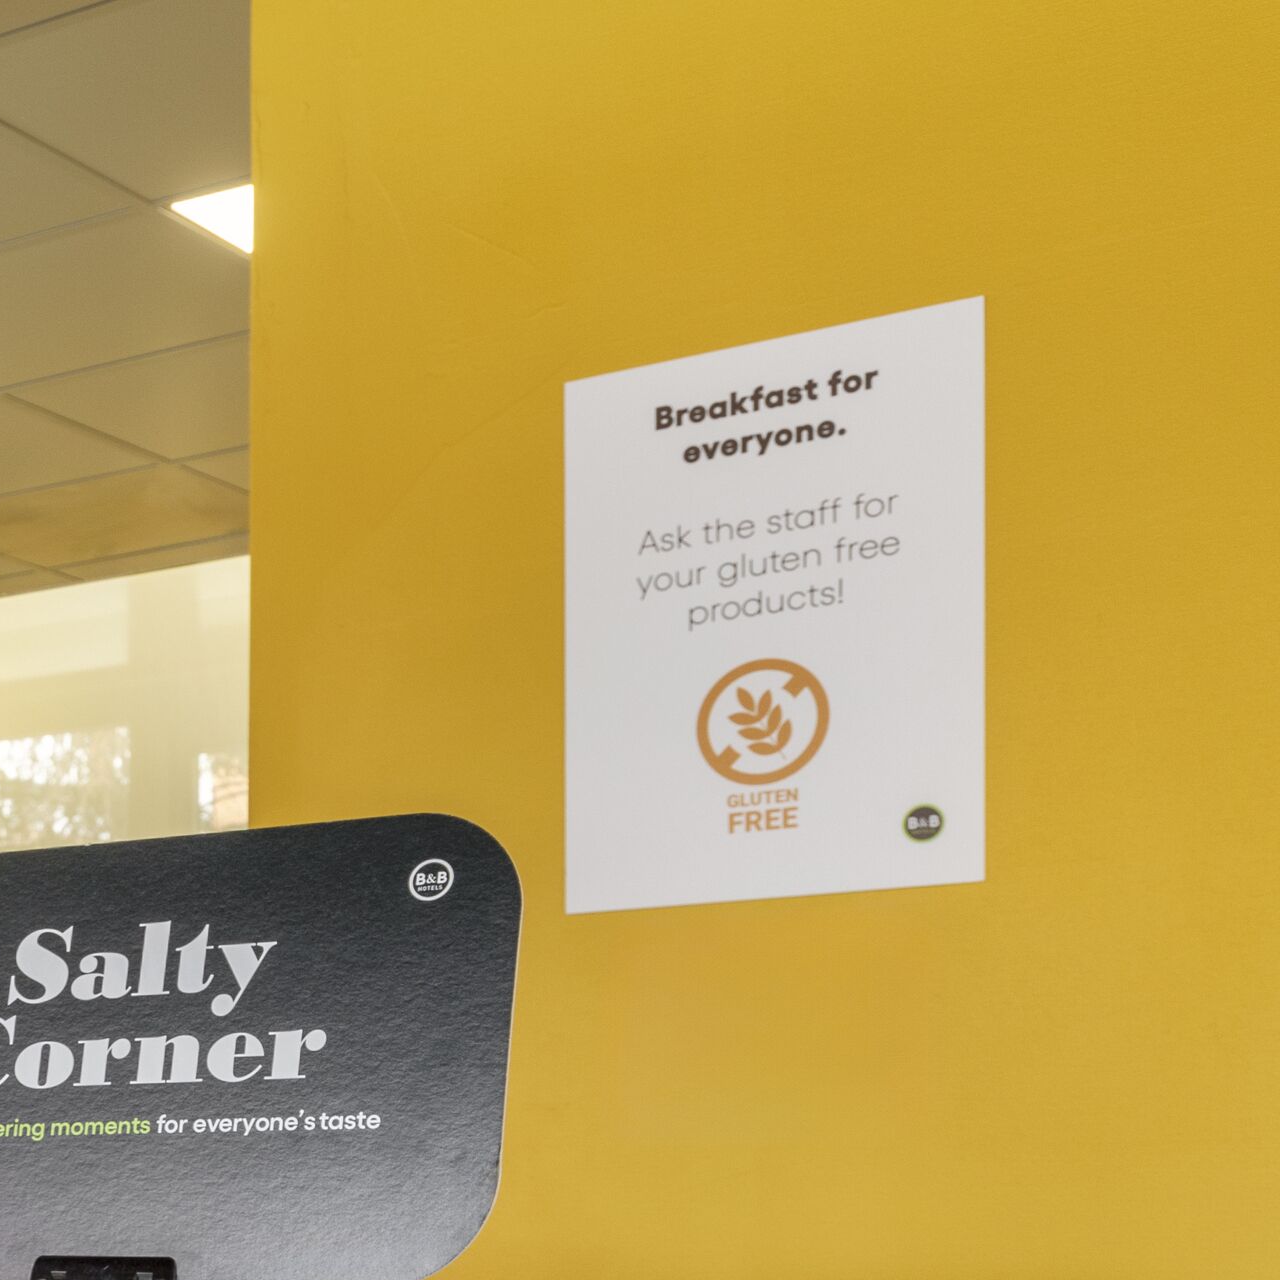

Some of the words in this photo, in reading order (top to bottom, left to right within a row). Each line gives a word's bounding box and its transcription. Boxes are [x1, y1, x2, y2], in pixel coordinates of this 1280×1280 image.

[654, 378, 819, 431] Breakfast
[829, 369, 880, 397] for
[682, 421, 848, 464] everyone.
[638, 527, 692, 557] Ask
[703, 516, 756, 546] the
[767, 497, 843, 536] staff
[853, 491, 900, 522] for
[636, 563, 707, 600] your
[717, 543, 823, 589] gluten
[834, 532, 901, 564] free
[687, 578, 845, 632] products!
[726, 788, 799, 808] GLUTEN
[728, 806, 799, 834] FREE
[415, 871, 448, 886] B&B
[7, 920, 278, 1016] Salty
[50, 1117, 151, 1137] moments
[156, 1113, 187, 1134] for
[320, 1111, 381, 1131] taste
